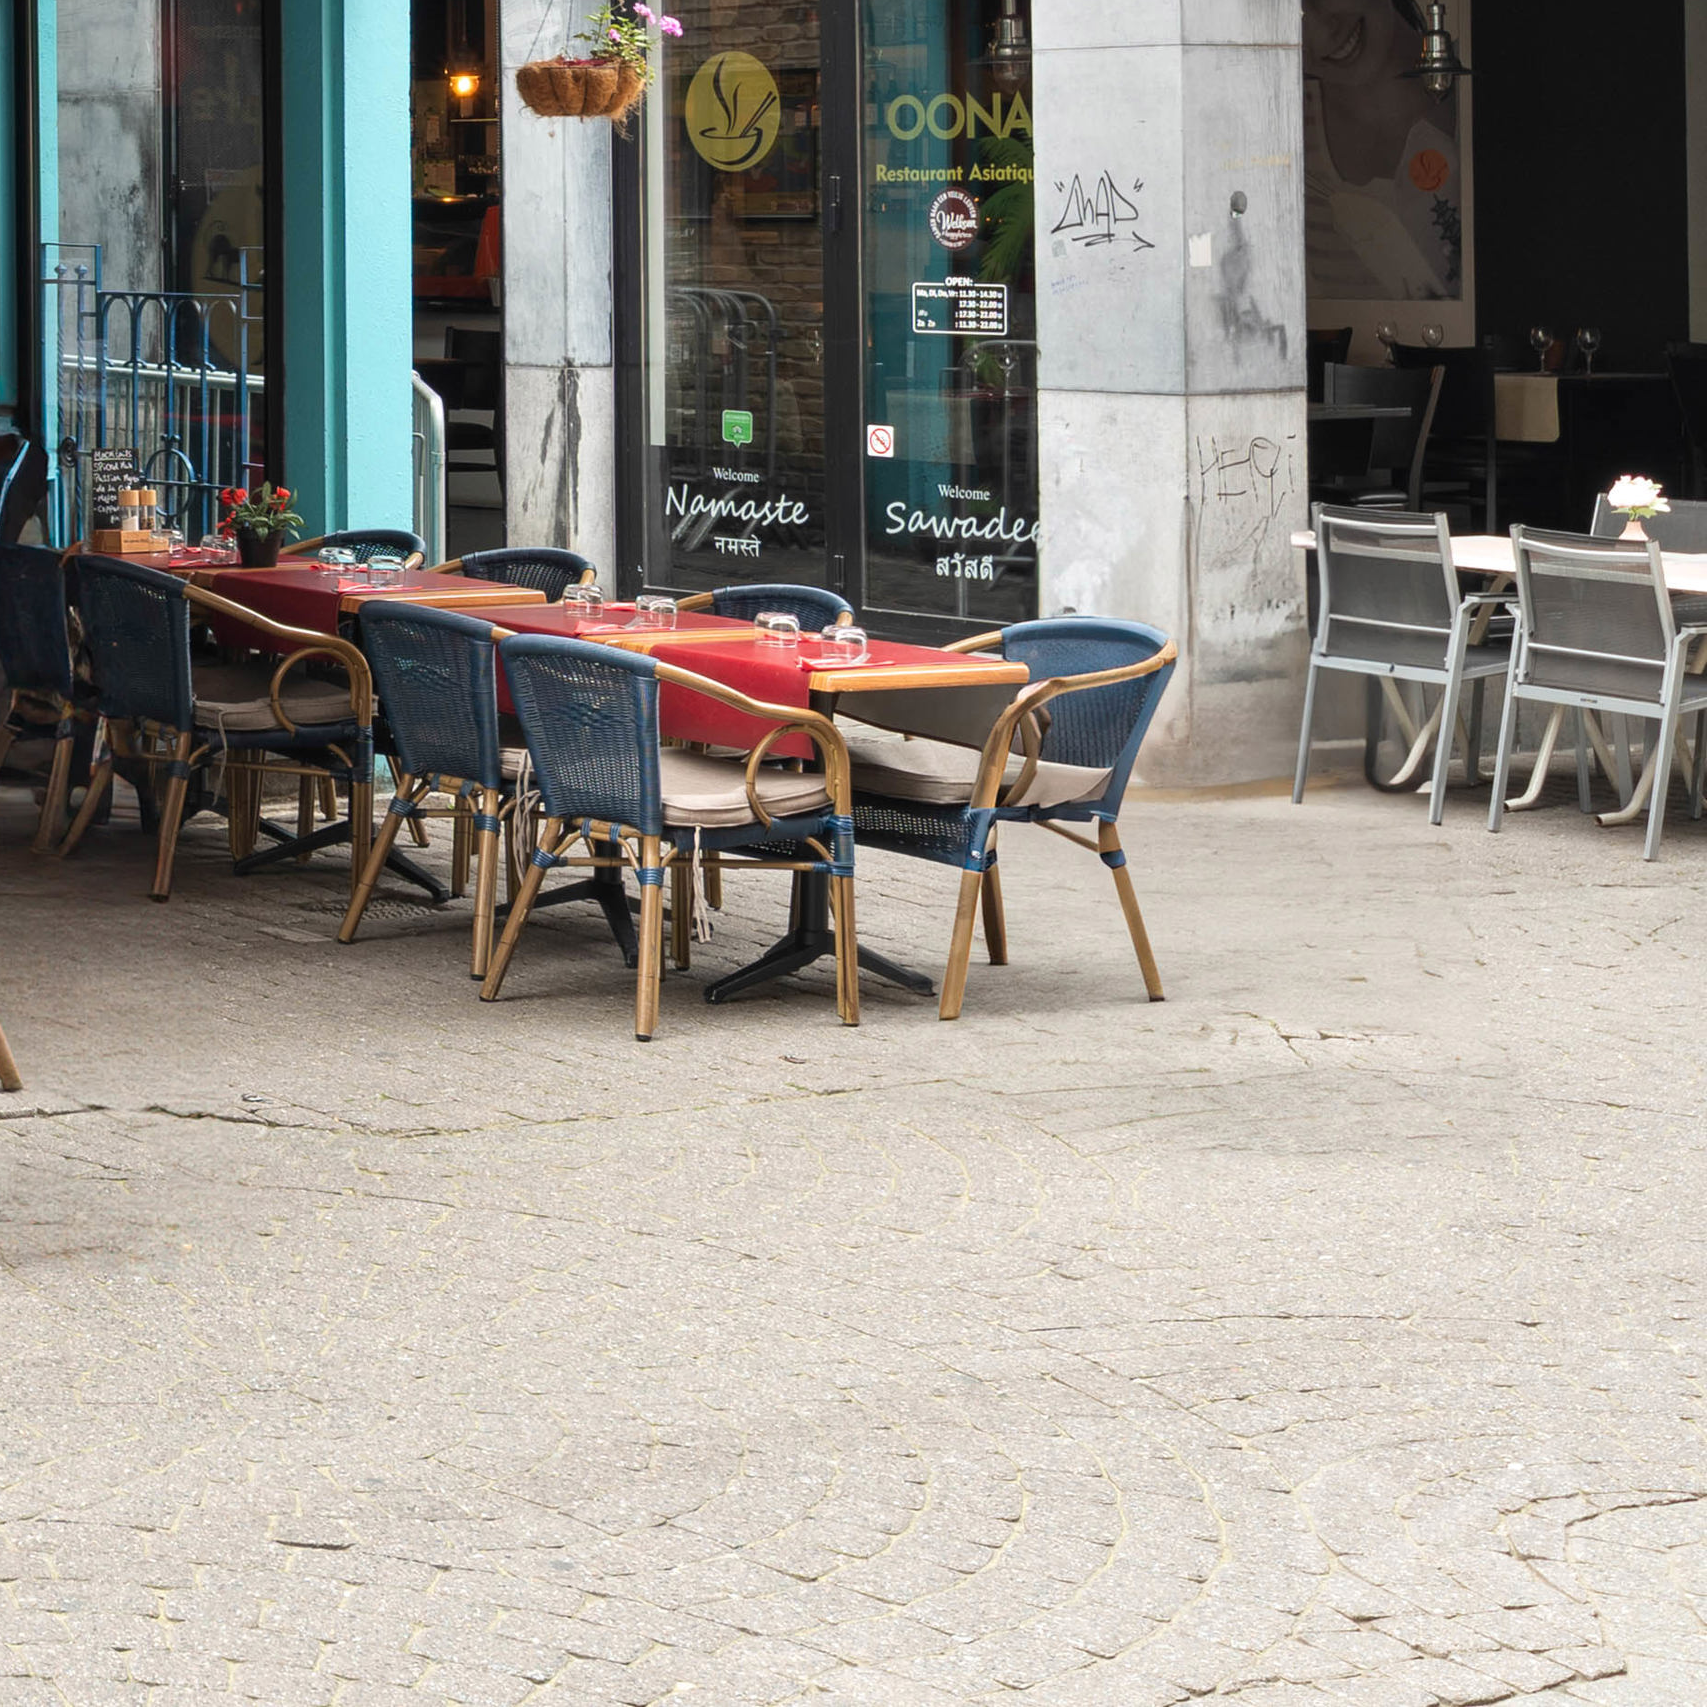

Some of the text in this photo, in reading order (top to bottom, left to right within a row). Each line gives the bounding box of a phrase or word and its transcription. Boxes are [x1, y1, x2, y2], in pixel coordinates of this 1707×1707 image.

[887, 89, 1033, 141] OONA
[875, 163, 963, 182] Restaurant
[944, 276, 974, 287] OPEN:
[712, 466, 761, 484] Welcome
[937, 484, 991, 501] Welcome
[665, 483, 810, 526] Namaste
[713, 534, 762, 558] नमस्ते
[936, 552, 994, 582] สวัสดี
